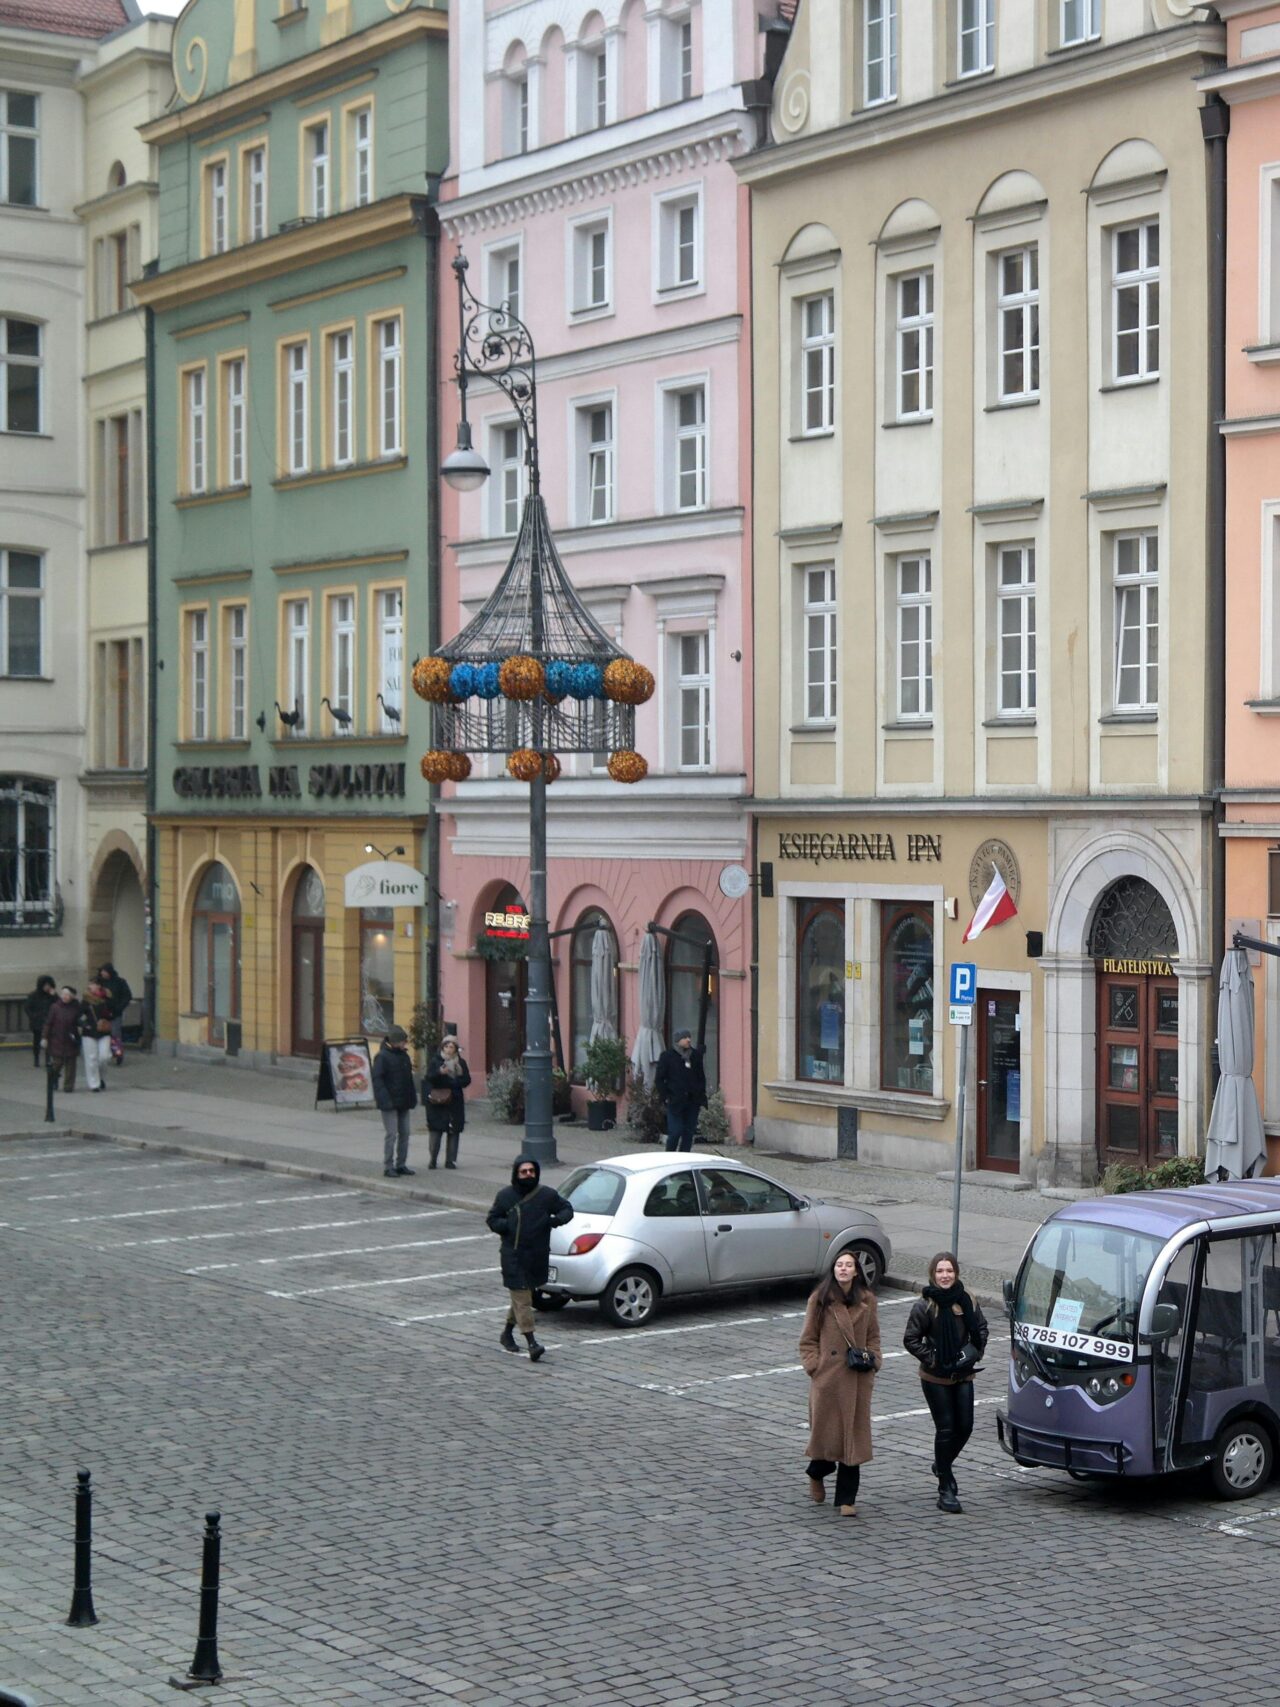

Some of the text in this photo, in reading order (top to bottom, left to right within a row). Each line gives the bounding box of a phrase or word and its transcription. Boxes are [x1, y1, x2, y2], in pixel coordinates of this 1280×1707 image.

[173, 762, 405, 798] GALERIA NA SOLNYM
[779, 833, 942, 866] KSIĘGARNIA IPN
[380, 879, 419, 895] fiore
[1103, 958, 1172, 976] FILATELISTYKA
[955, 967, 970, 999] P
[1032, 1328, 1058, 1344] 785
[1062, 1334, 1089, 1350] 107
[1093, 1341, 1131, 1359] 999
